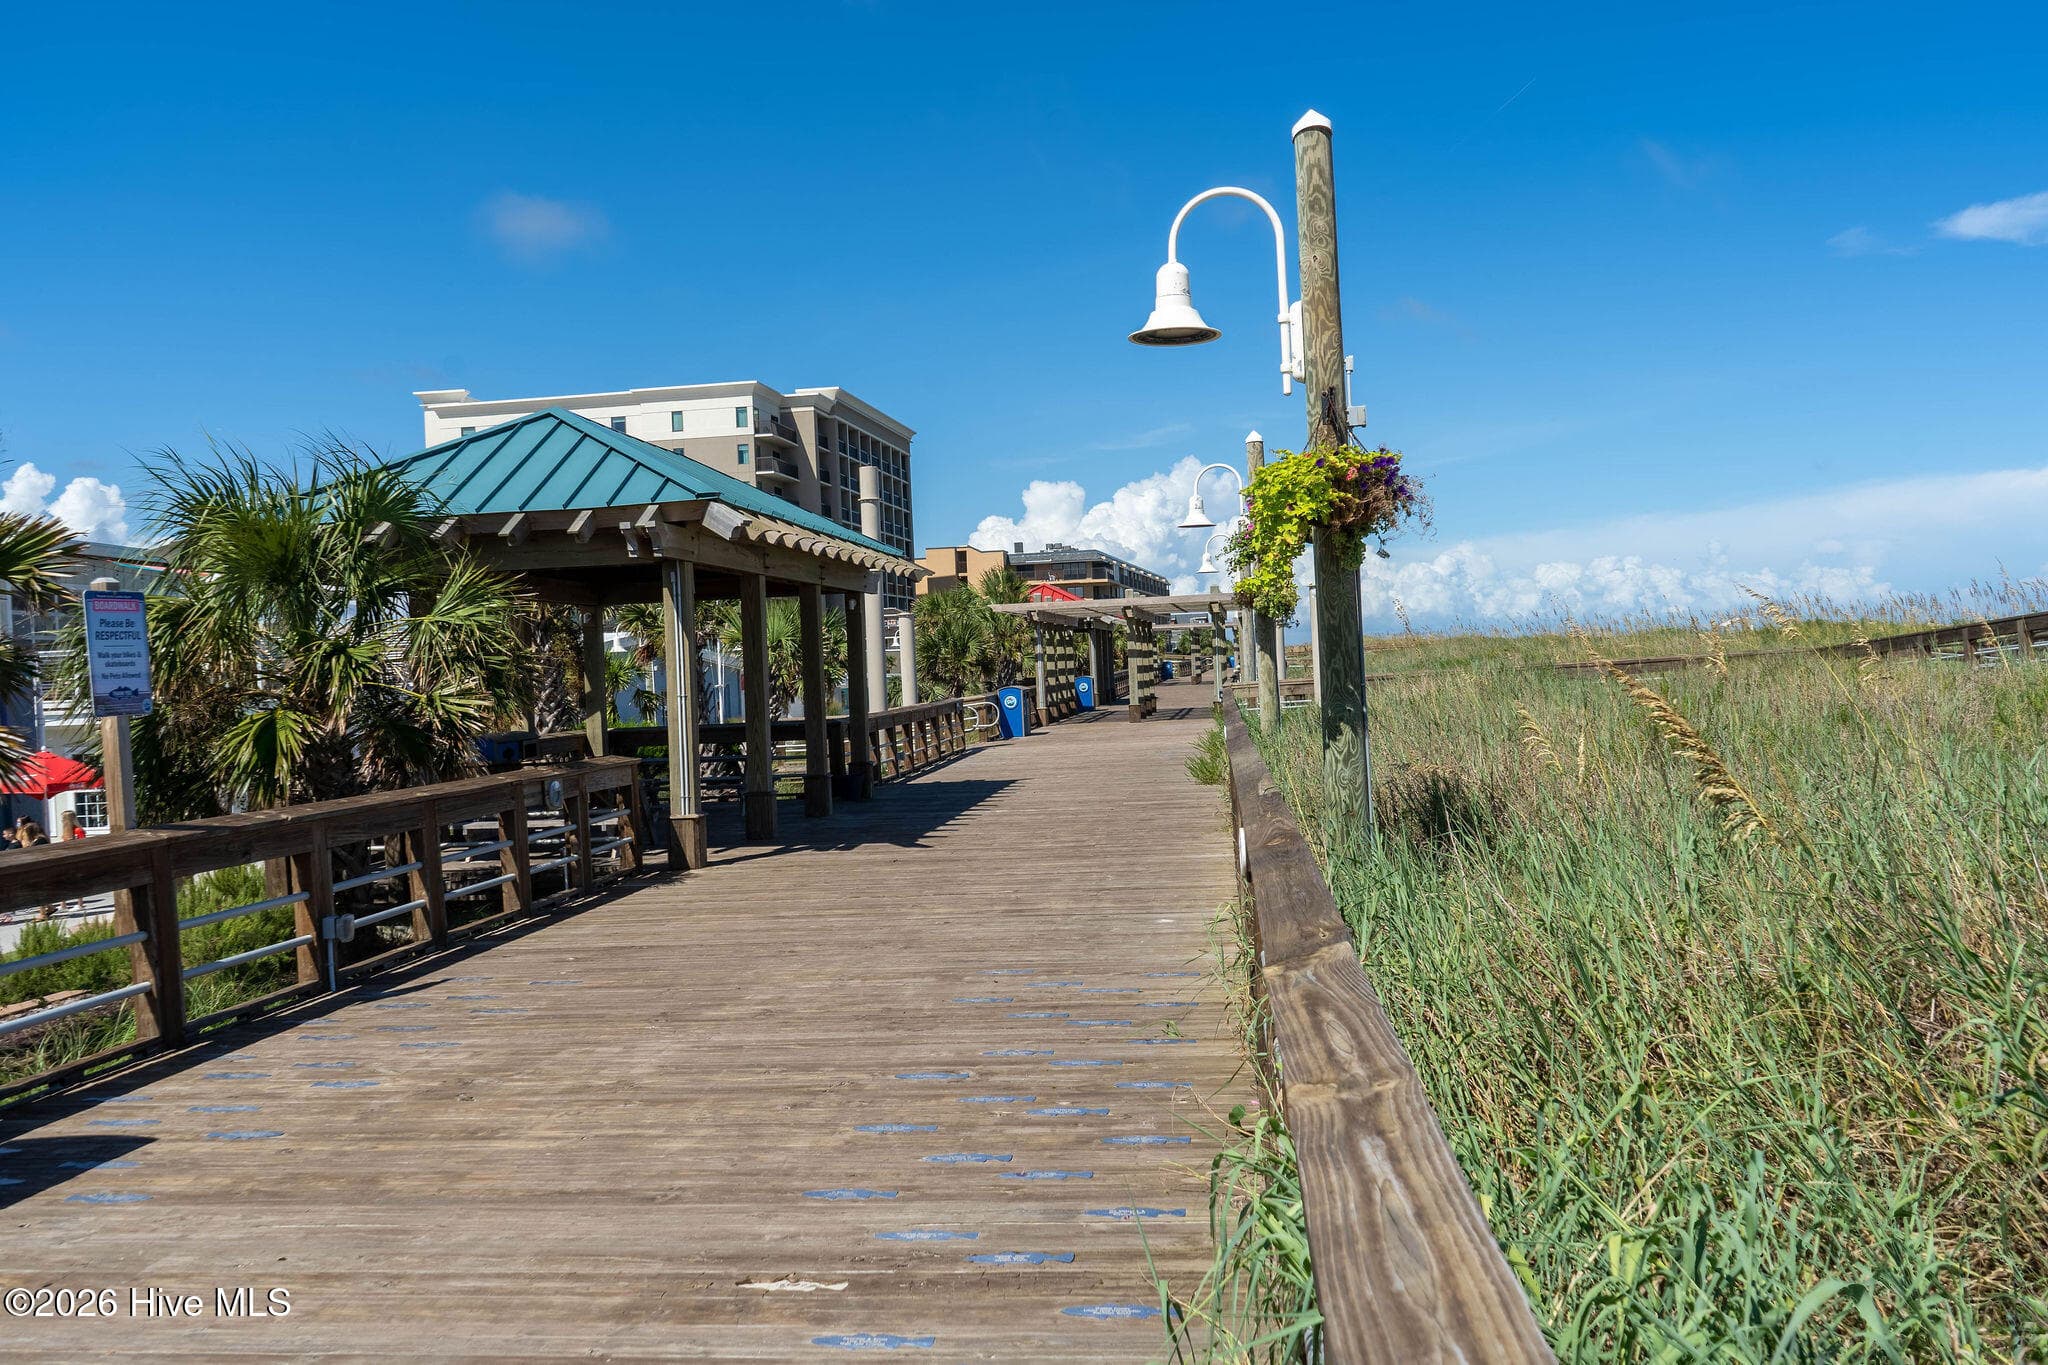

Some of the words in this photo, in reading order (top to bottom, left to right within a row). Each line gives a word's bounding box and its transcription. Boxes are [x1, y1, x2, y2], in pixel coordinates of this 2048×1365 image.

[94, 600, 138, 611] BOARDWALK
[99, 618, 123, 628] Please
[125, 618, 135, 628] Be
[94, 630, 142, 641] RESPECTFUL
